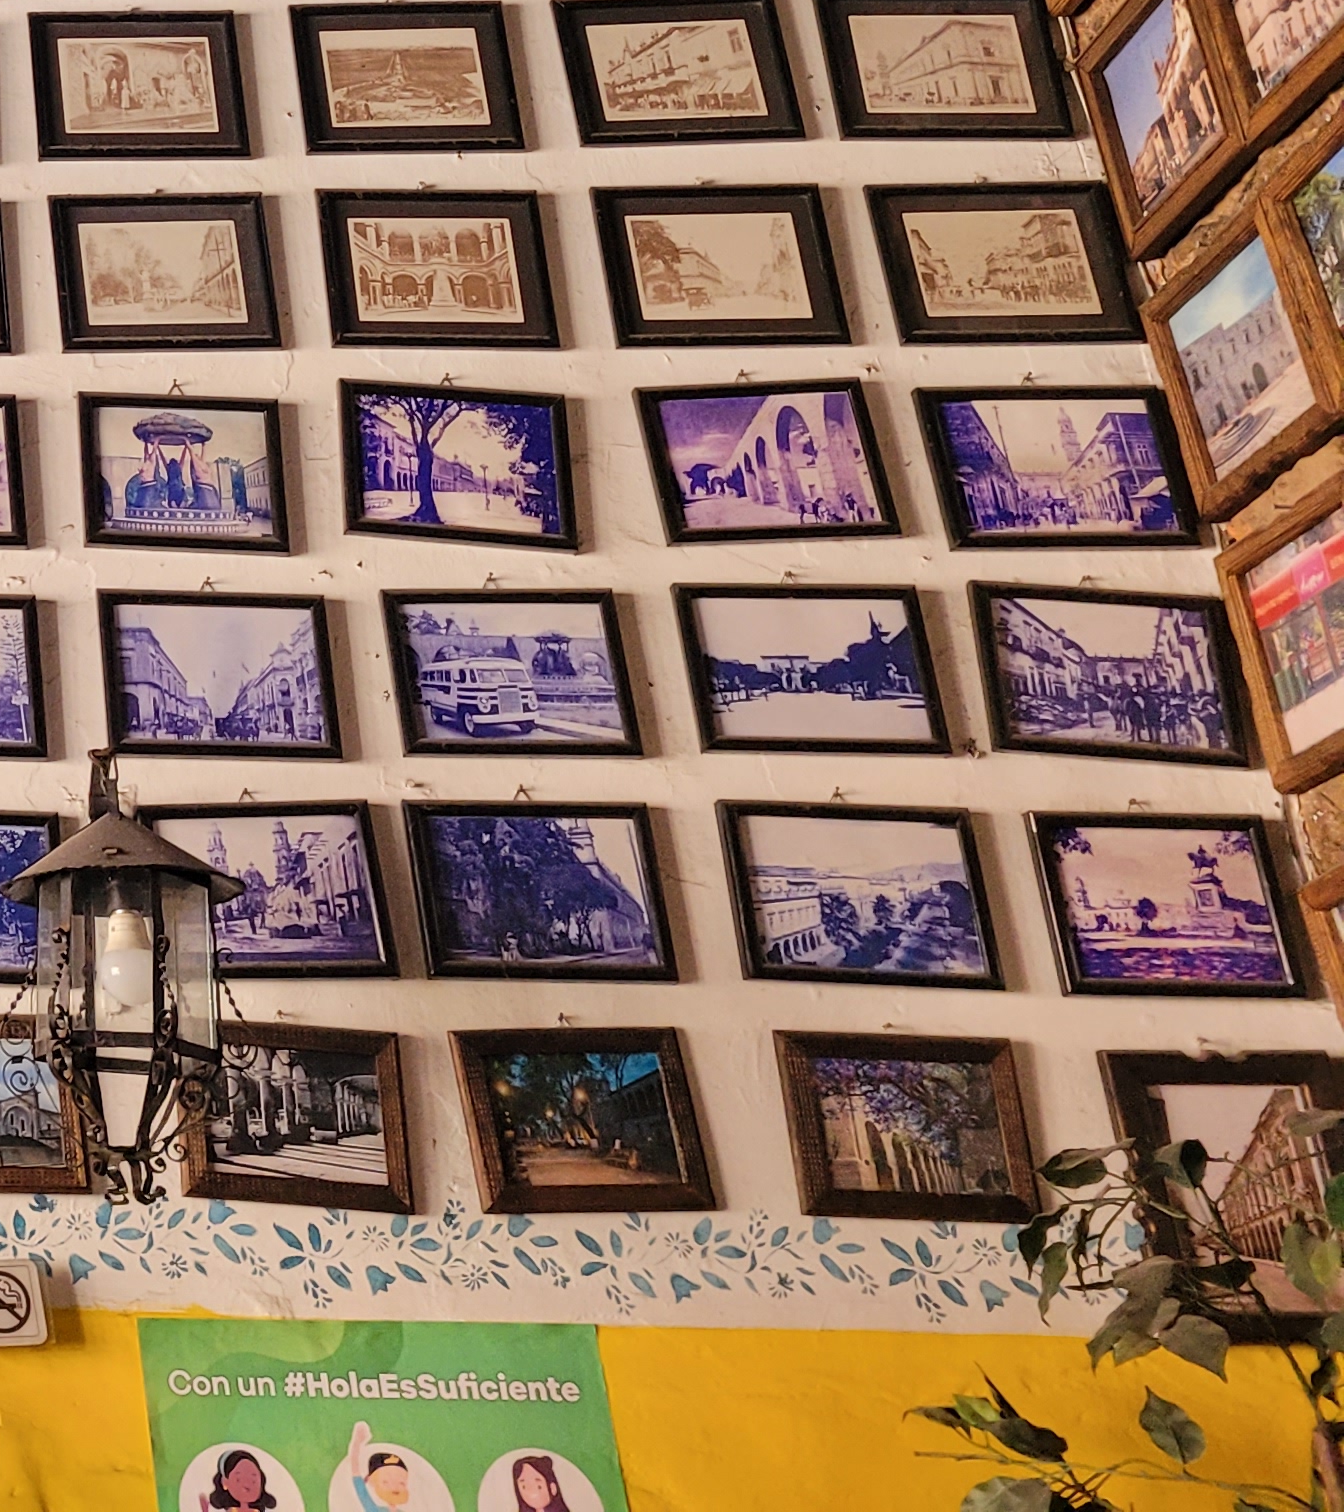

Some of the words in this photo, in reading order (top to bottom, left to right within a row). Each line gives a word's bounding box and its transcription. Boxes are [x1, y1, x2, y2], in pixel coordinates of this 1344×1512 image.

[167, 1368, 230, 1397] Con
[236, 1374, 277, 1397] un
[283, 1370, 581, 1403] #HolaEsSuficiente
